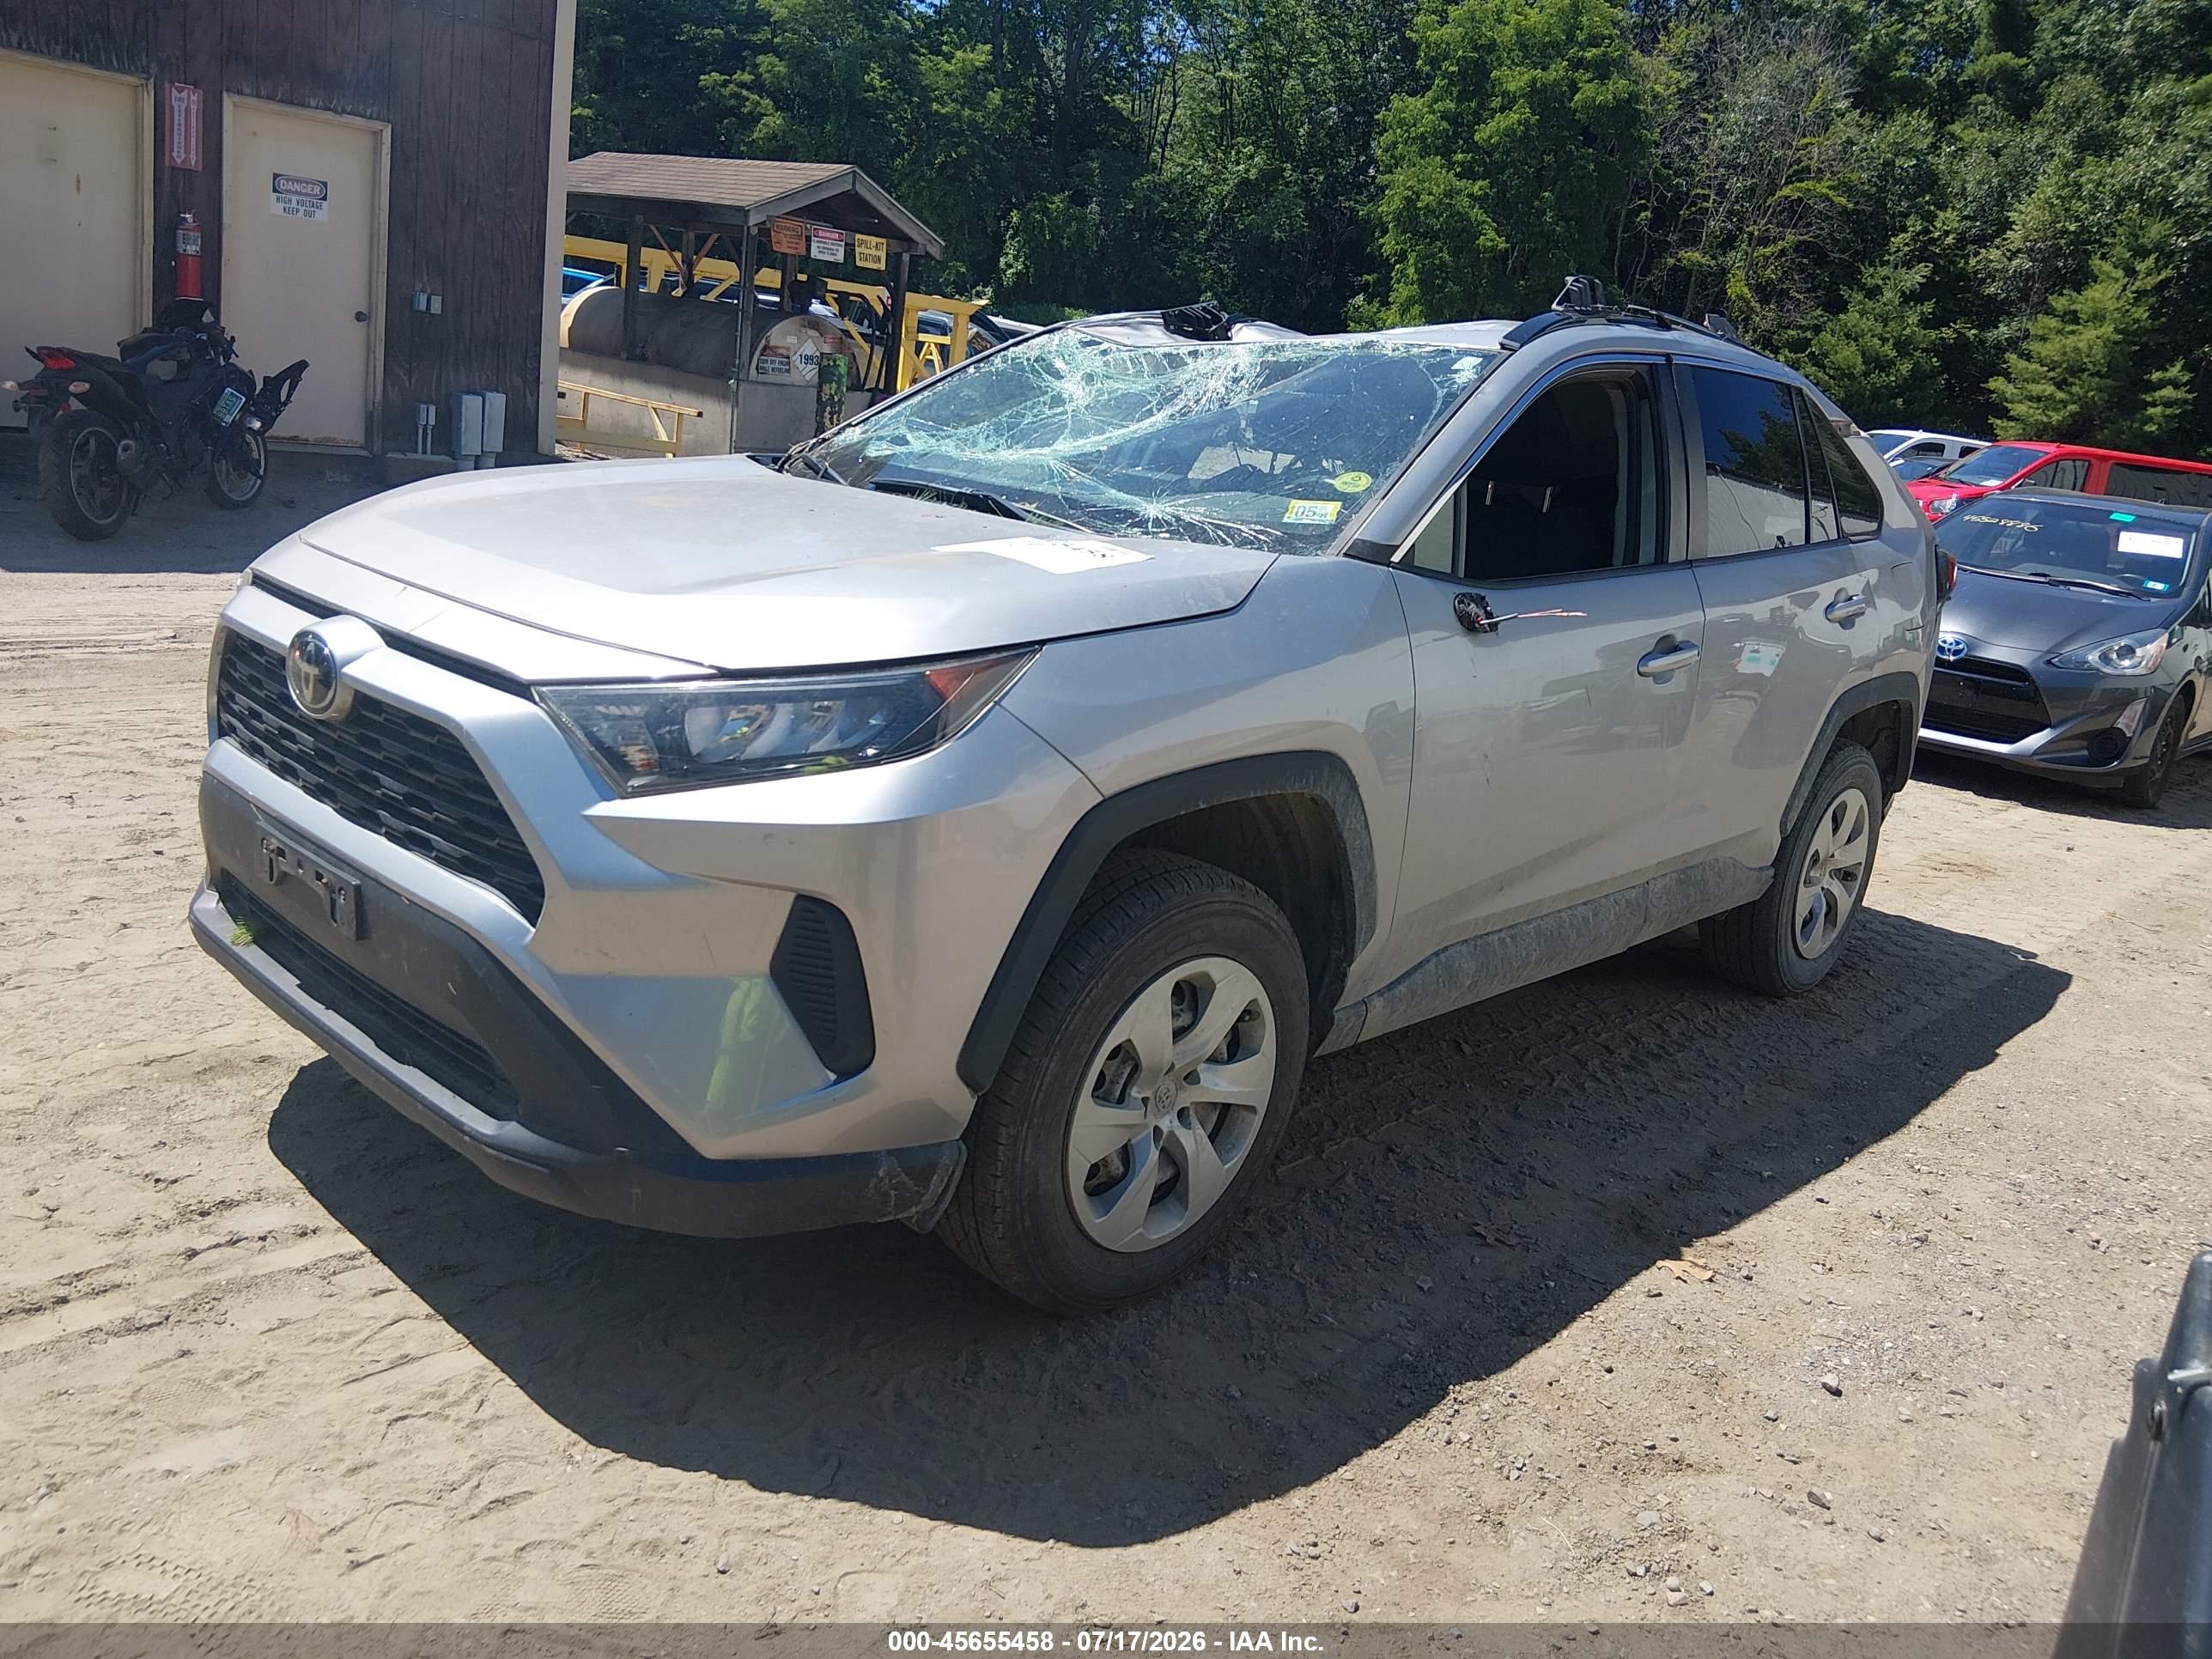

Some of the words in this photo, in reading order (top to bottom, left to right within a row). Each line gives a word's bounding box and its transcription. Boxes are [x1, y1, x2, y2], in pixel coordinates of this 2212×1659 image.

[279, 179, 321, 196] DANGER
[276, 194, 292, 205] HIGH
[296, 198, 324, 210] VOLTAGE
[283, 206, 300, 216] KEEP
[303, 209, 316, 219] OUT
[775, 223, 799, 234] WARNING
[818, 229, 839, 240] DANGER
[856, 237, 884, 252] SPILL-KIT
[859, 252, 881, 264] STATION
[799, 354, 819, 366] 1993
